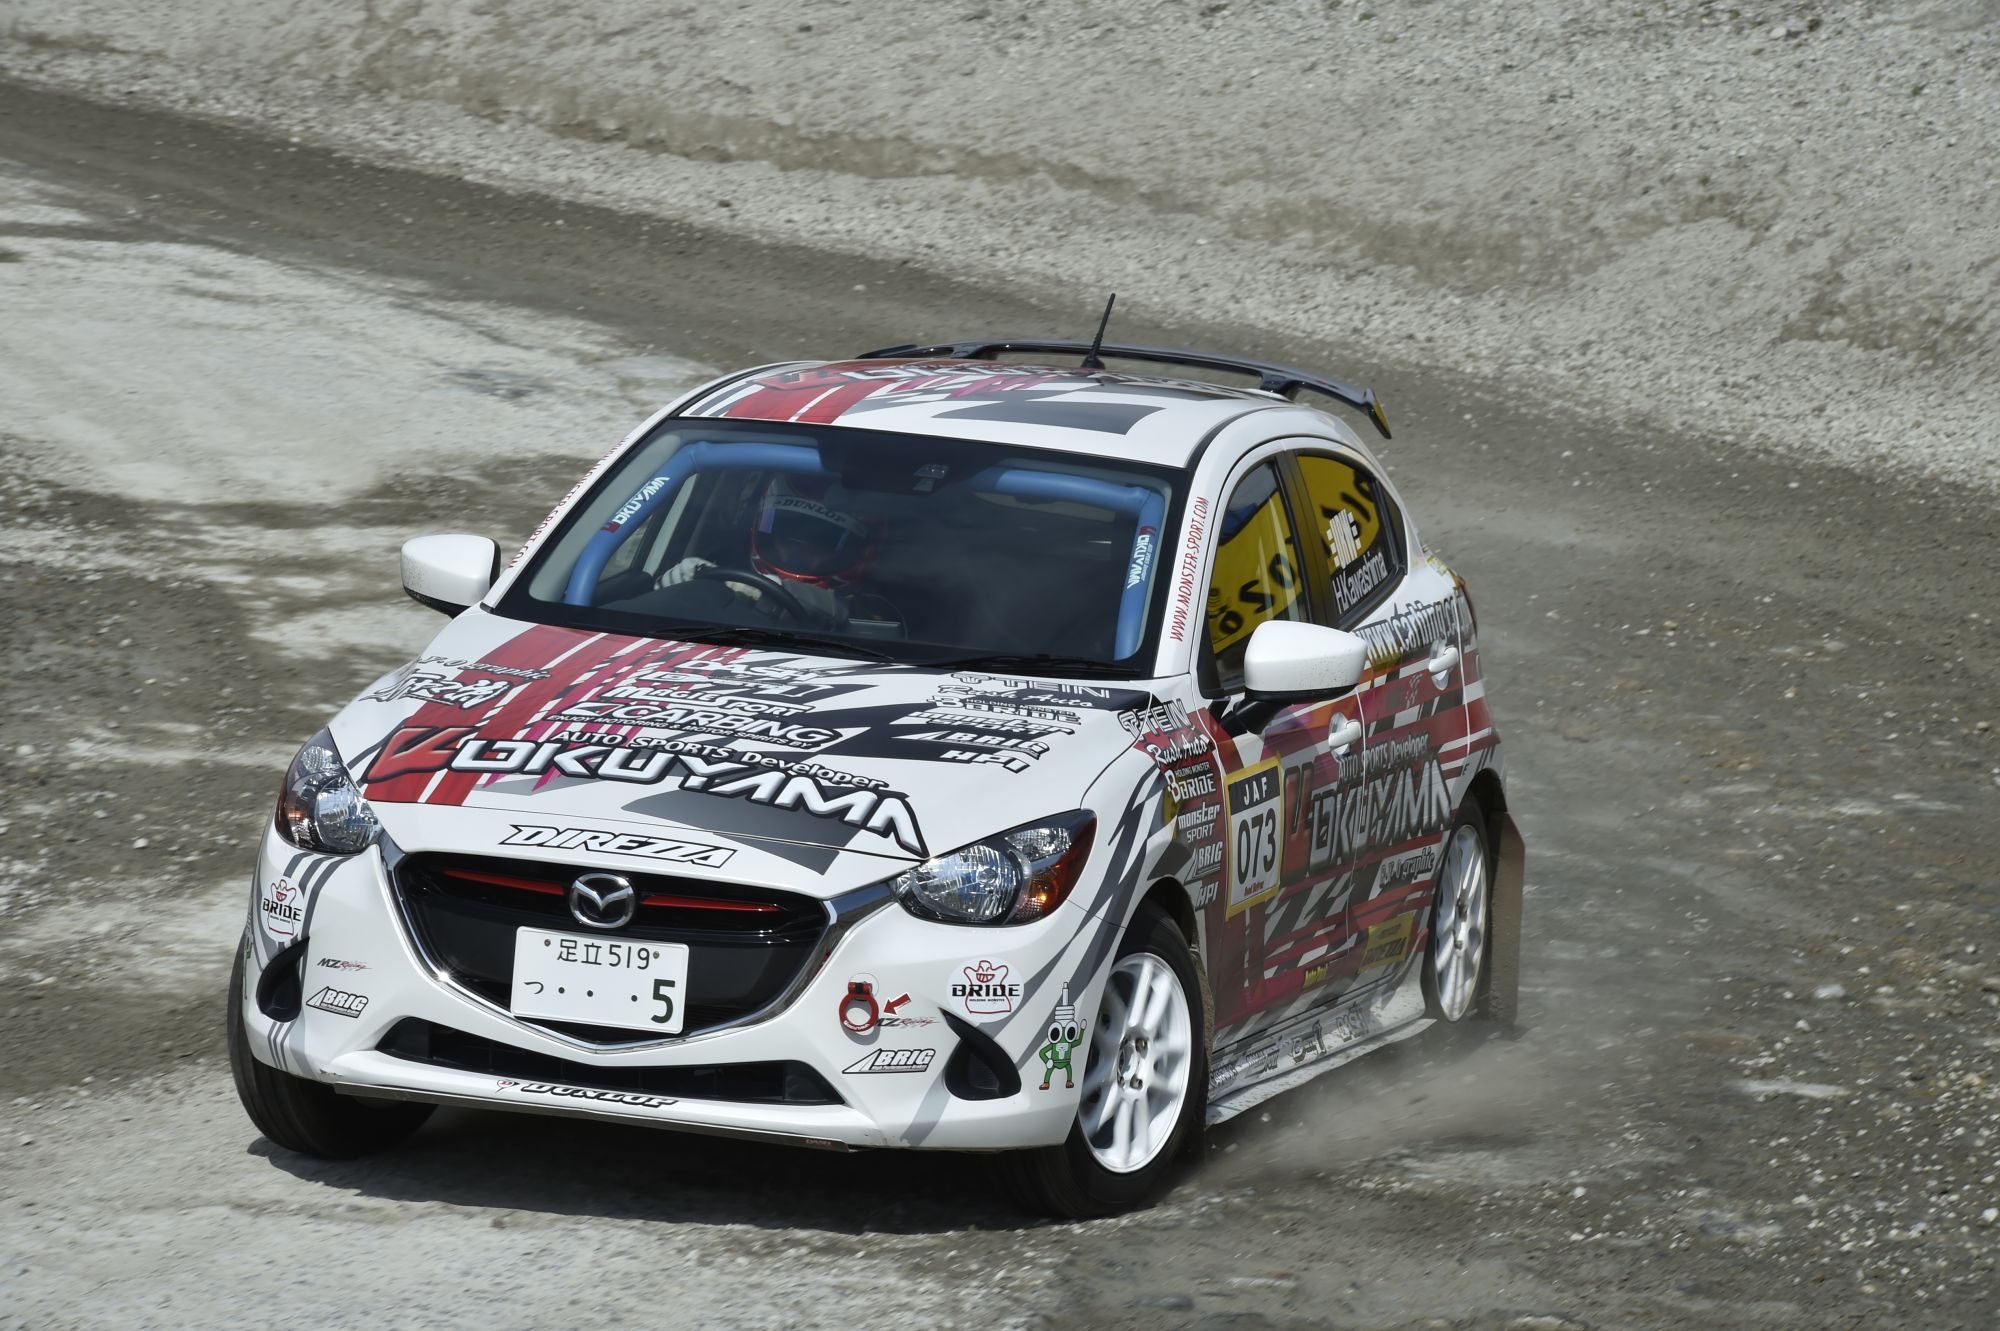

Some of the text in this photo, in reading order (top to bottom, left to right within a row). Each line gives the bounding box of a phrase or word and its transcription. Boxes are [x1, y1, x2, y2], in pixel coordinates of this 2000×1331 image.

[613, 476, 670, 525] OKUYAMA
[783, 499, 847, 522] DUNLOP
[1170, 496, 1209, 642] WWW.MONSTER-SPORT.COM
[993, 677, 1111, 699] TEIN
[1022, 693, 1096, 708] Auto
[966, 698, 1077, 717] HOLDING MONSTER
[1137, 698, 1193, 736] TEIN
[547, 714, 595, 722] ENJOY
[599, 717, 668, 729] MOTORING
[684, 724, 733, 736] MOTOR
[734, 731, 789, 745] SPIRITS
[789, 740, 813, 749] BY
[611, 705, 836, 744] CARBING
[907, 711, 1076, 736] monster
[927, 718, 1043, 735] SPORT
[550, 730, 890, 790] AUTO SPORTS Developer
[939, 750, 1031, 774] HPI
[1147, 734, 1210, 765] Rush Auto
[1339, 733, 1429, 781] AUTO SPORTS Developer
[449, 738, 930, 858] OKUYAMA
[1179, 773, 1216, 800] BRIDE
[1244, 777, 1267, 806] JAF
[1178, 801, 1221, 830] monster
[1309, 759, 1453, 868] OKUYAMA
[499, 824, 738, 868] DIREZZA
[1187, 822, 1215, 843] SPORT
[1238, 808, 1276, 885] 073
[262, 898, 303, 922] BRIDE
[523, 978, 676, 1024] つ 5
[951, 983, 1021, 997] BRIDE
[521, 1082, 679, 1109] DUNLOP
